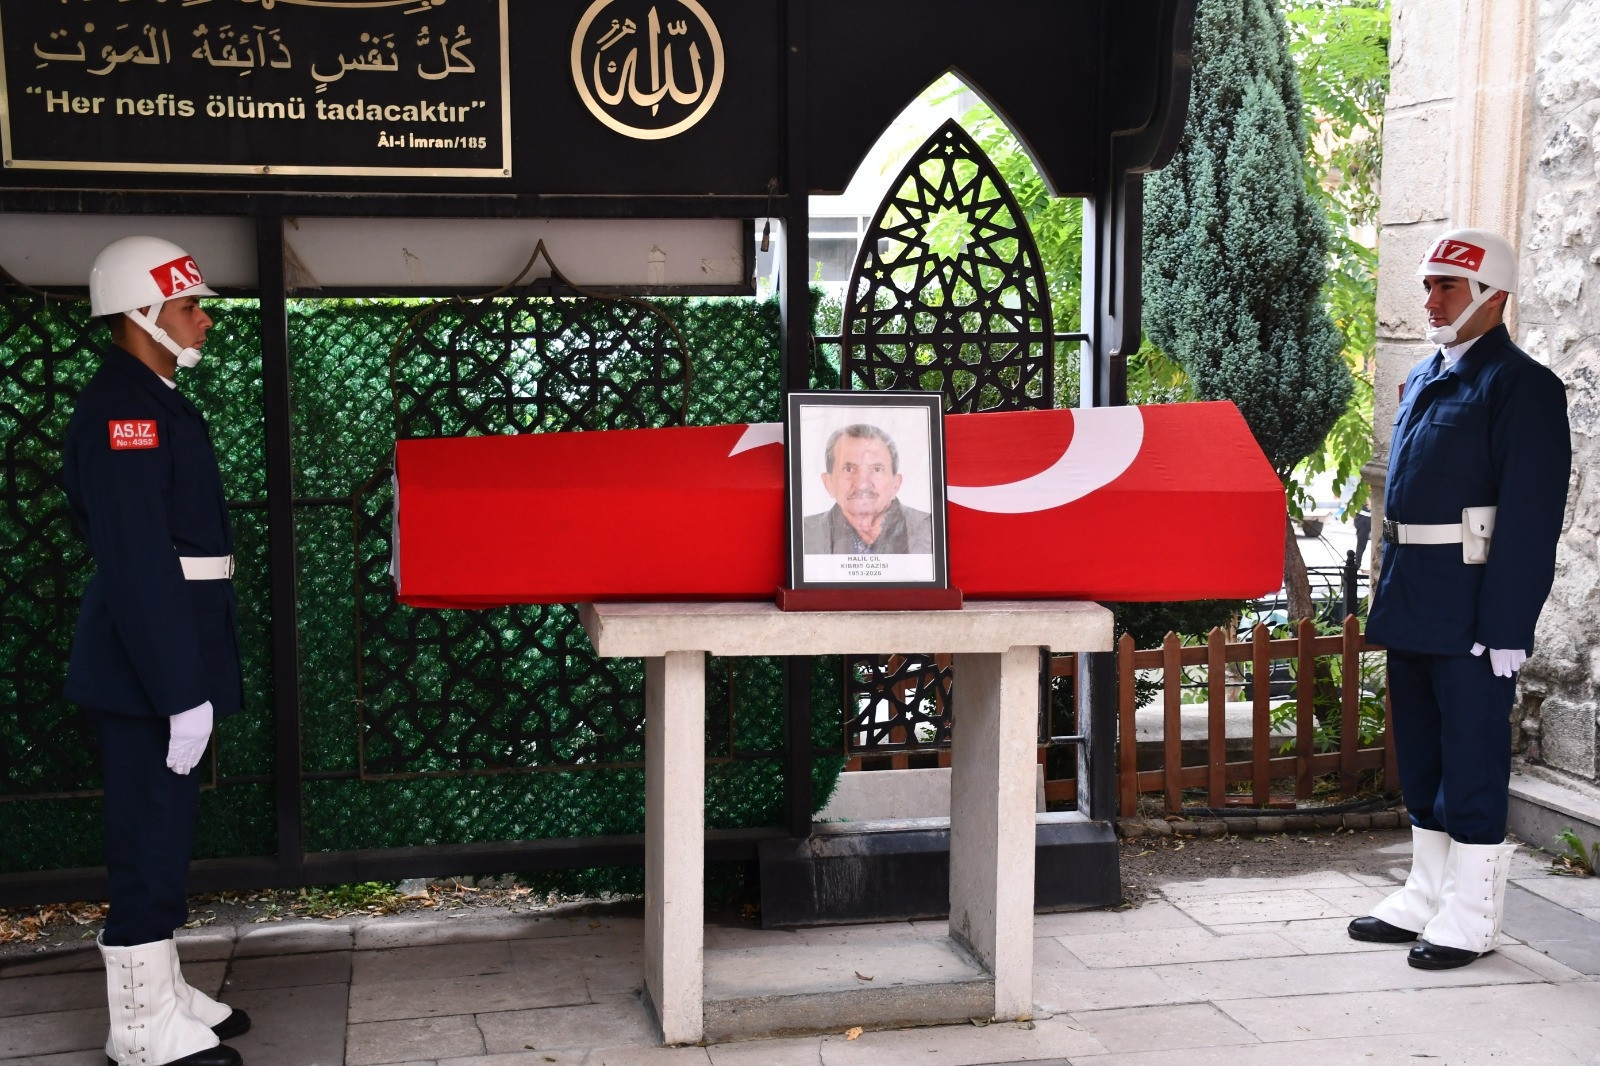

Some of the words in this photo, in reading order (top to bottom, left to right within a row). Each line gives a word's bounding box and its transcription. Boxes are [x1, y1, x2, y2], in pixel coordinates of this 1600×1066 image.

[115, 93, 196, 118] nefis
[205, 94, 306, 120] ölümü
[409, 132, 487, 149] İmran/185
